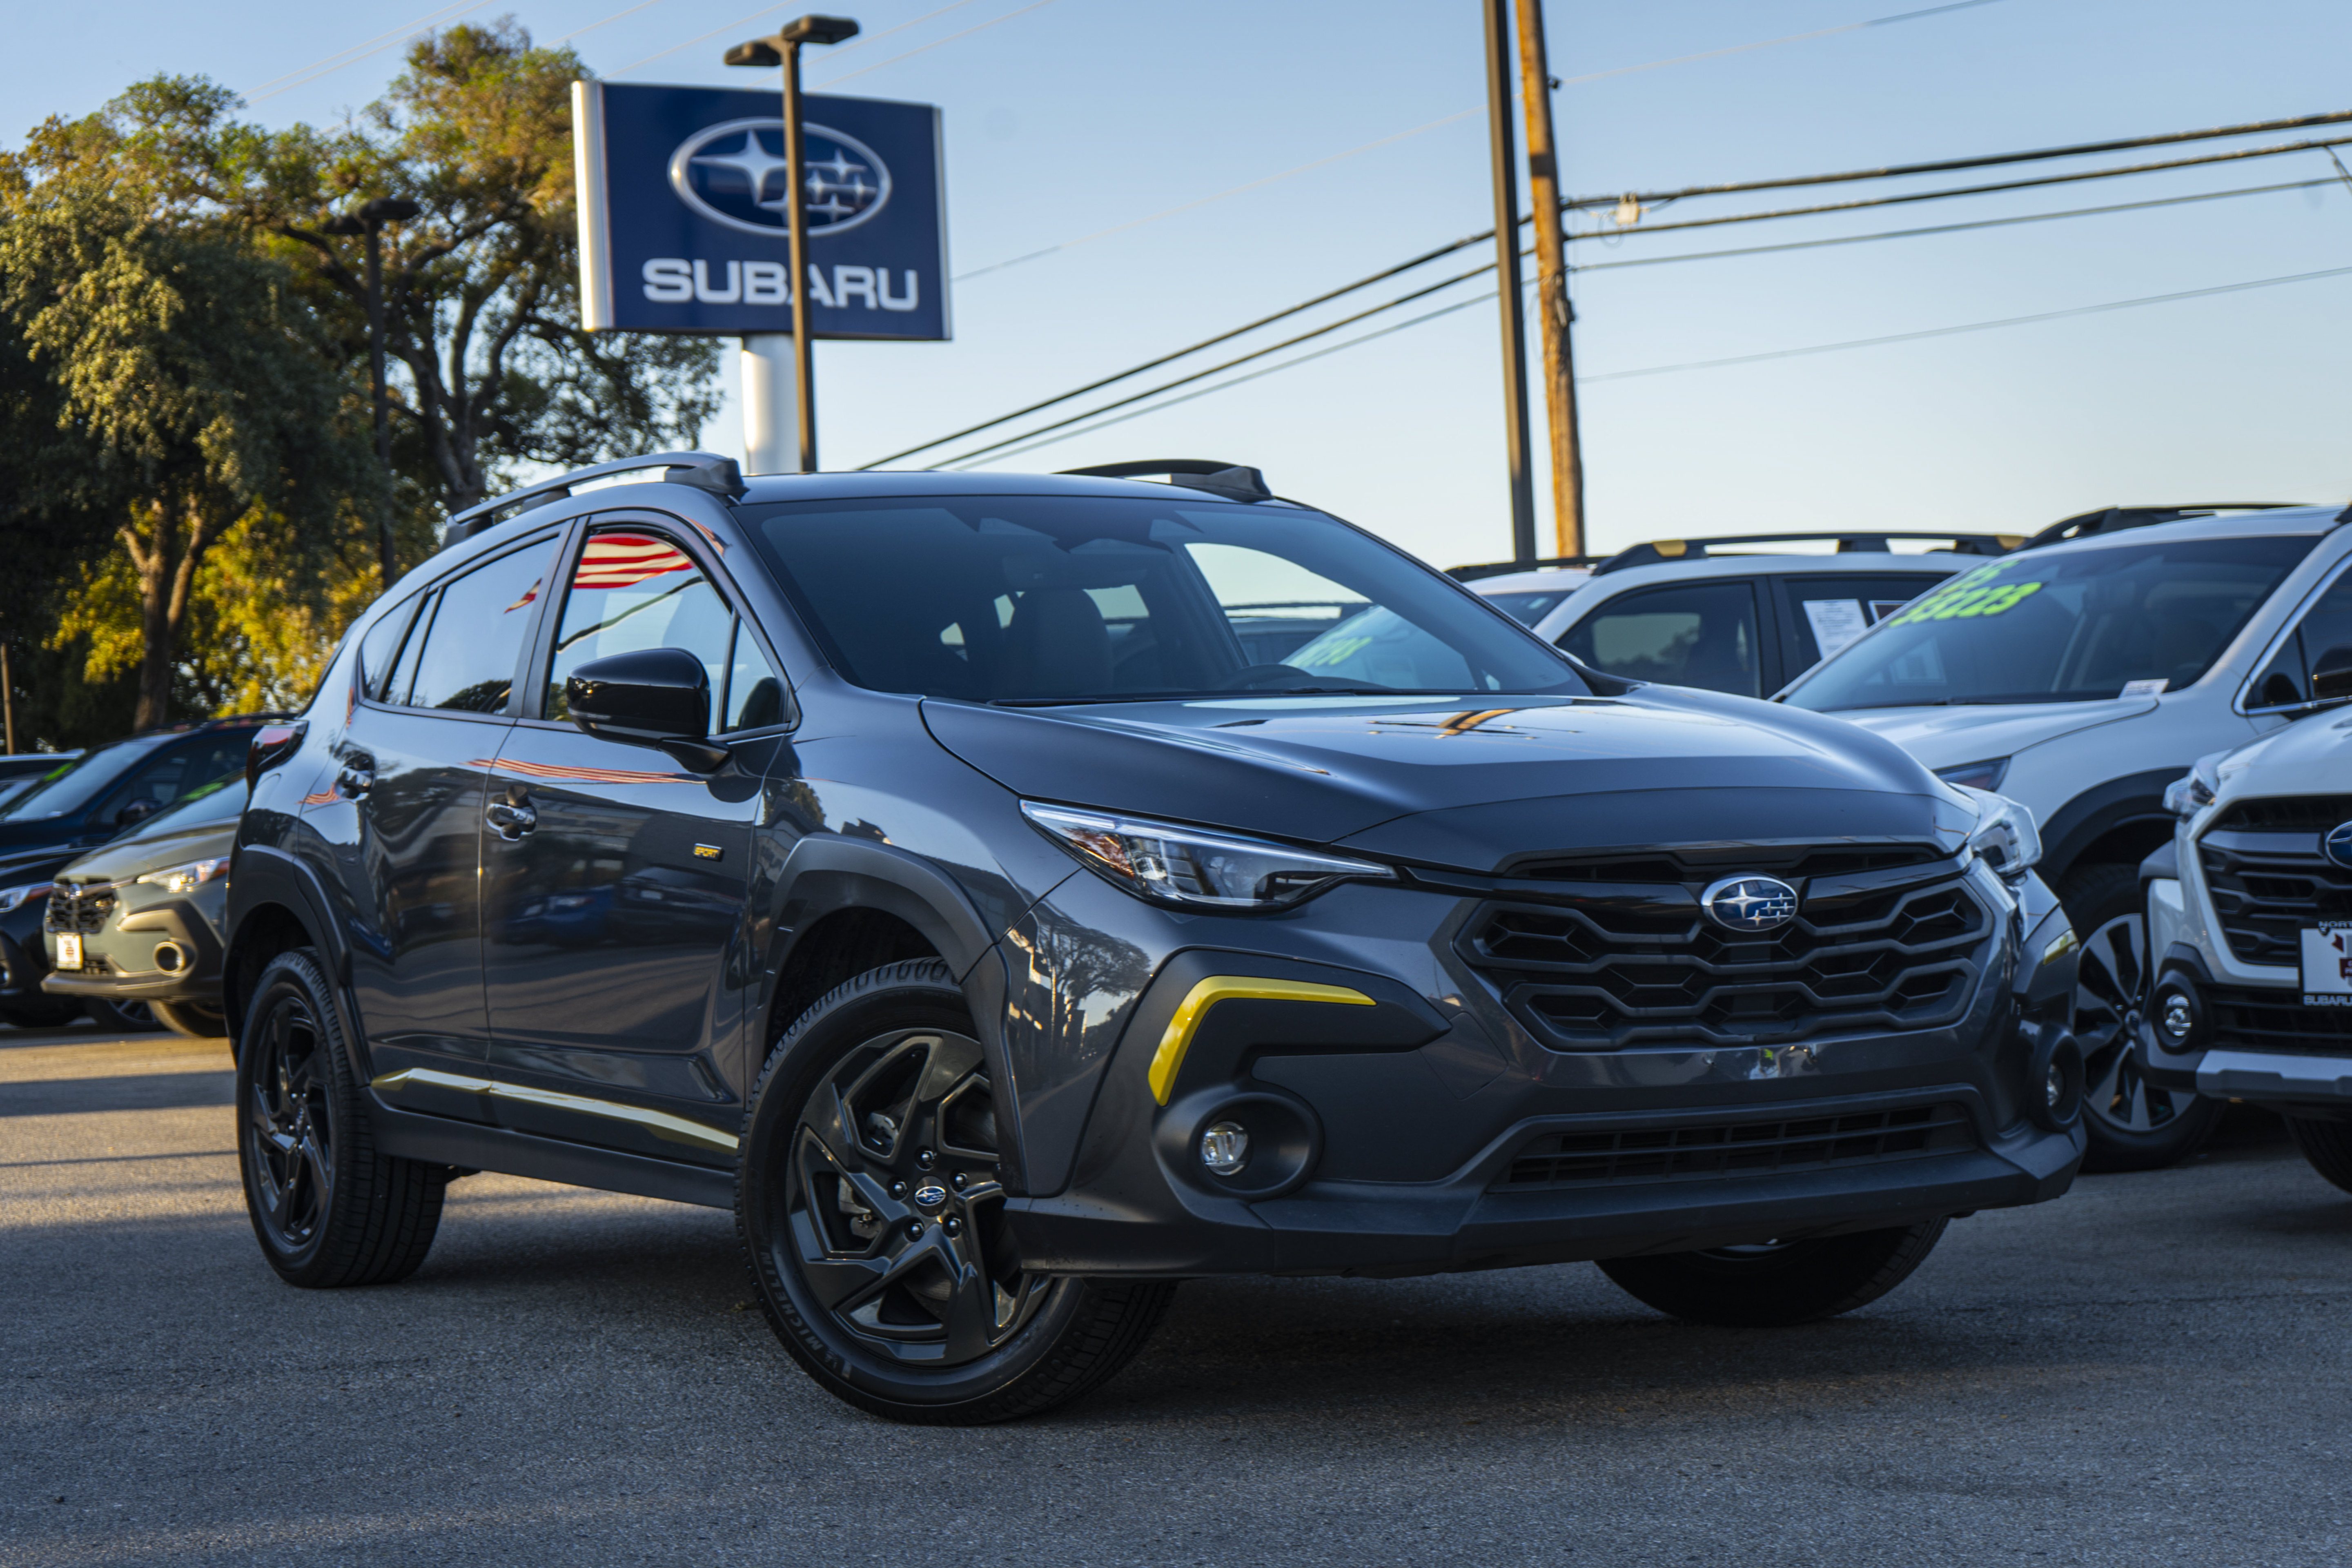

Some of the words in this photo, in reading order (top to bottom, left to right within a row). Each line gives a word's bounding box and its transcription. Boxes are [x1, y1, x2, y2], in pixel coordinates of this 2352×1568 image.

[642, 258, 918, 311] SUBARU
[694, 846, 719, 858] SPORT
[760, 1251, 823, 1351] MICHELIN
